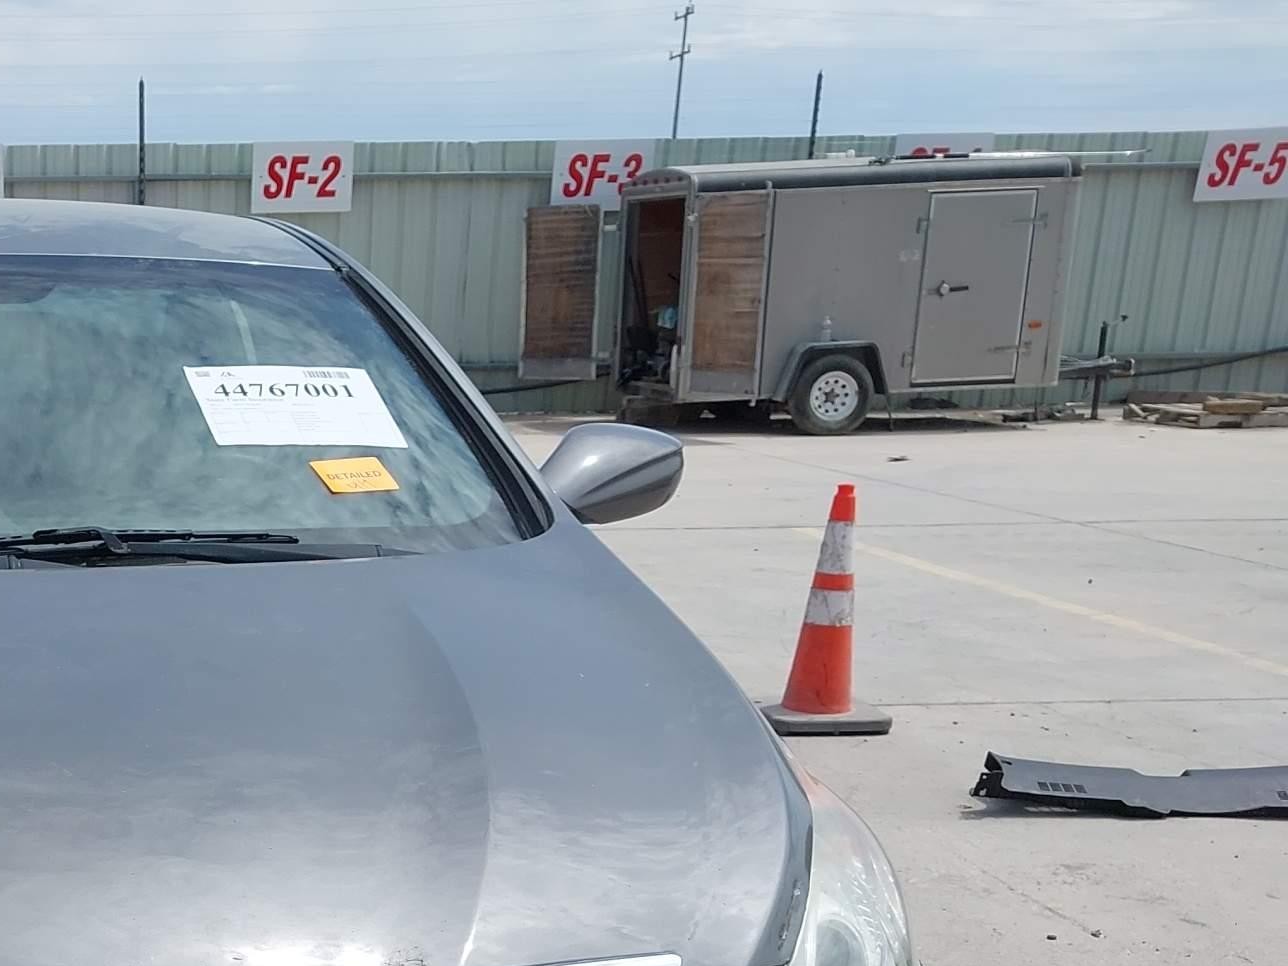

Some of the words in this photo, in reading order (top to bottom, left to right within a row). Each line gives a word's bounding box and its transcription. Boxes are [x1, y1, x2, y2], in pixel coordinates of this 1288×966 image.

[263, 155, 342, 199] SF-2
[1207, 143, 1288, 188] SF-5
[214, 383, 355, 398] 44767001
[326, 470, 382, 481] DETAILED
